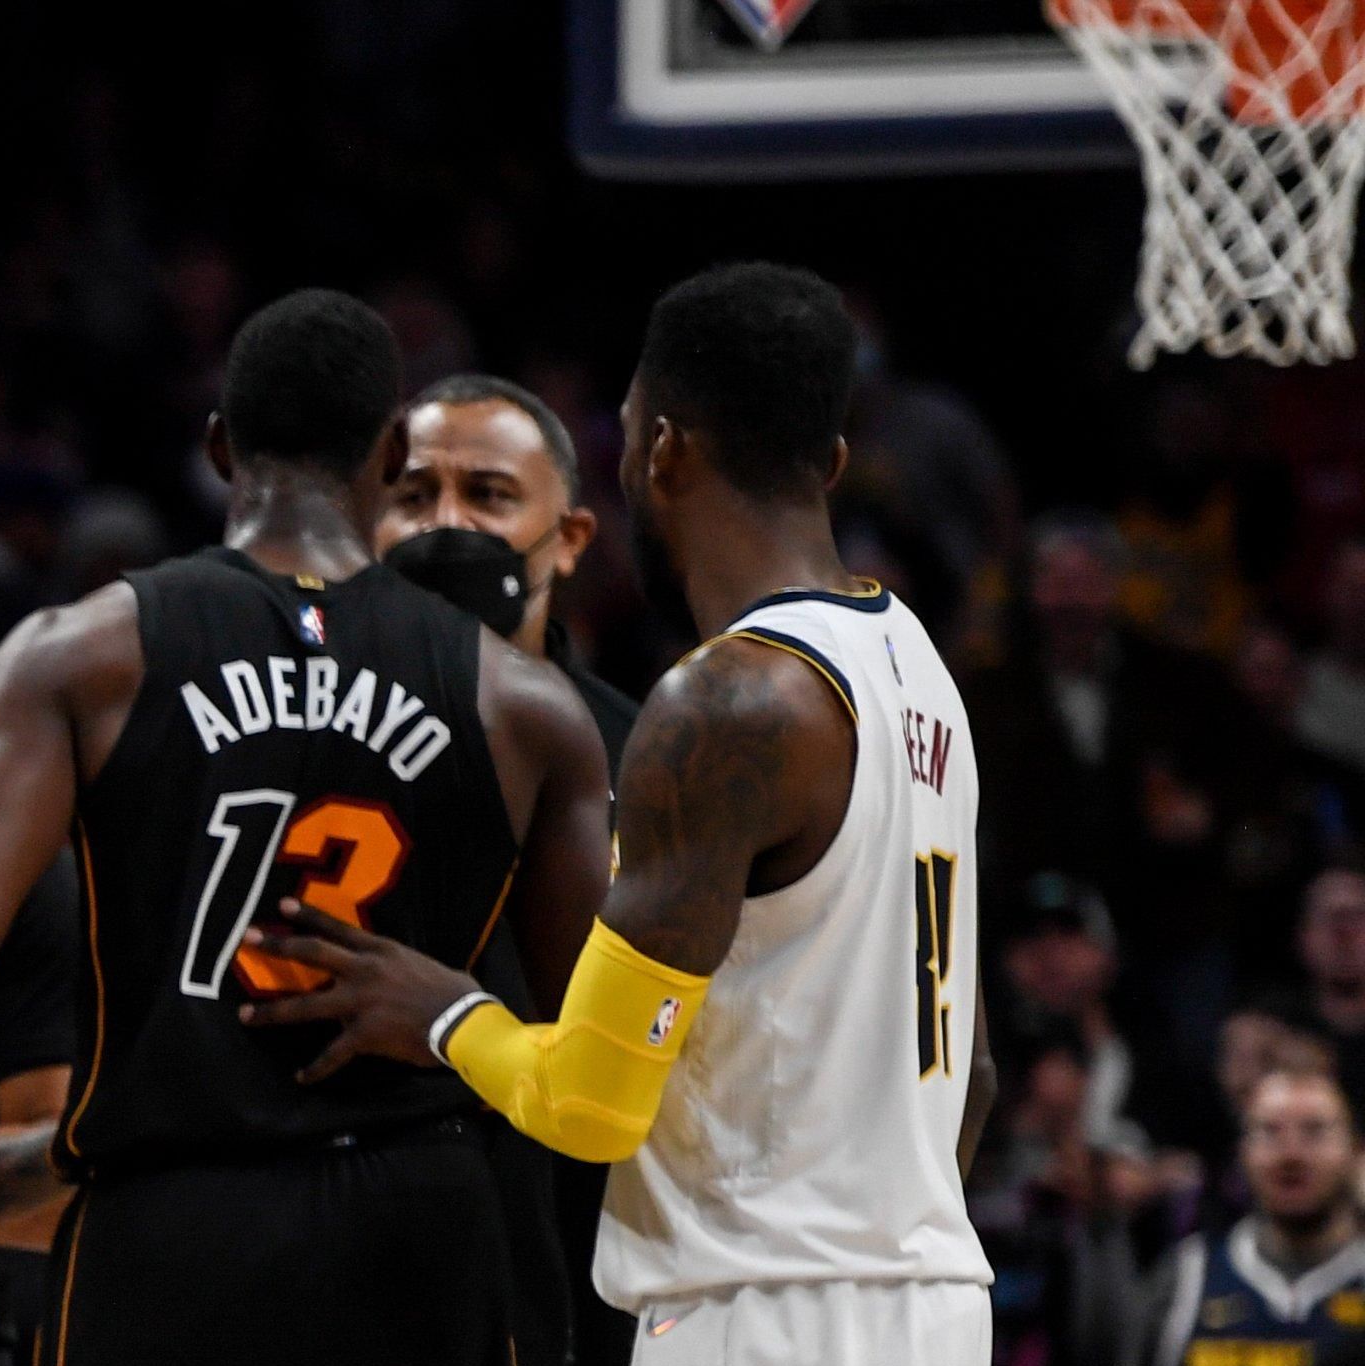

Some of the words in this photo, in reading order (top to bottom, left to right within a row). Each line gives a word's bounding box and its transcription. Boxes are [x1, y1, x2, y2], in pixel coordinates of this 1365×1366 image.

[180, 655, 451, 783] ADEBAYO
[901, 706, 952, 797] EEN
[180, 788, 411, 1001] 13
